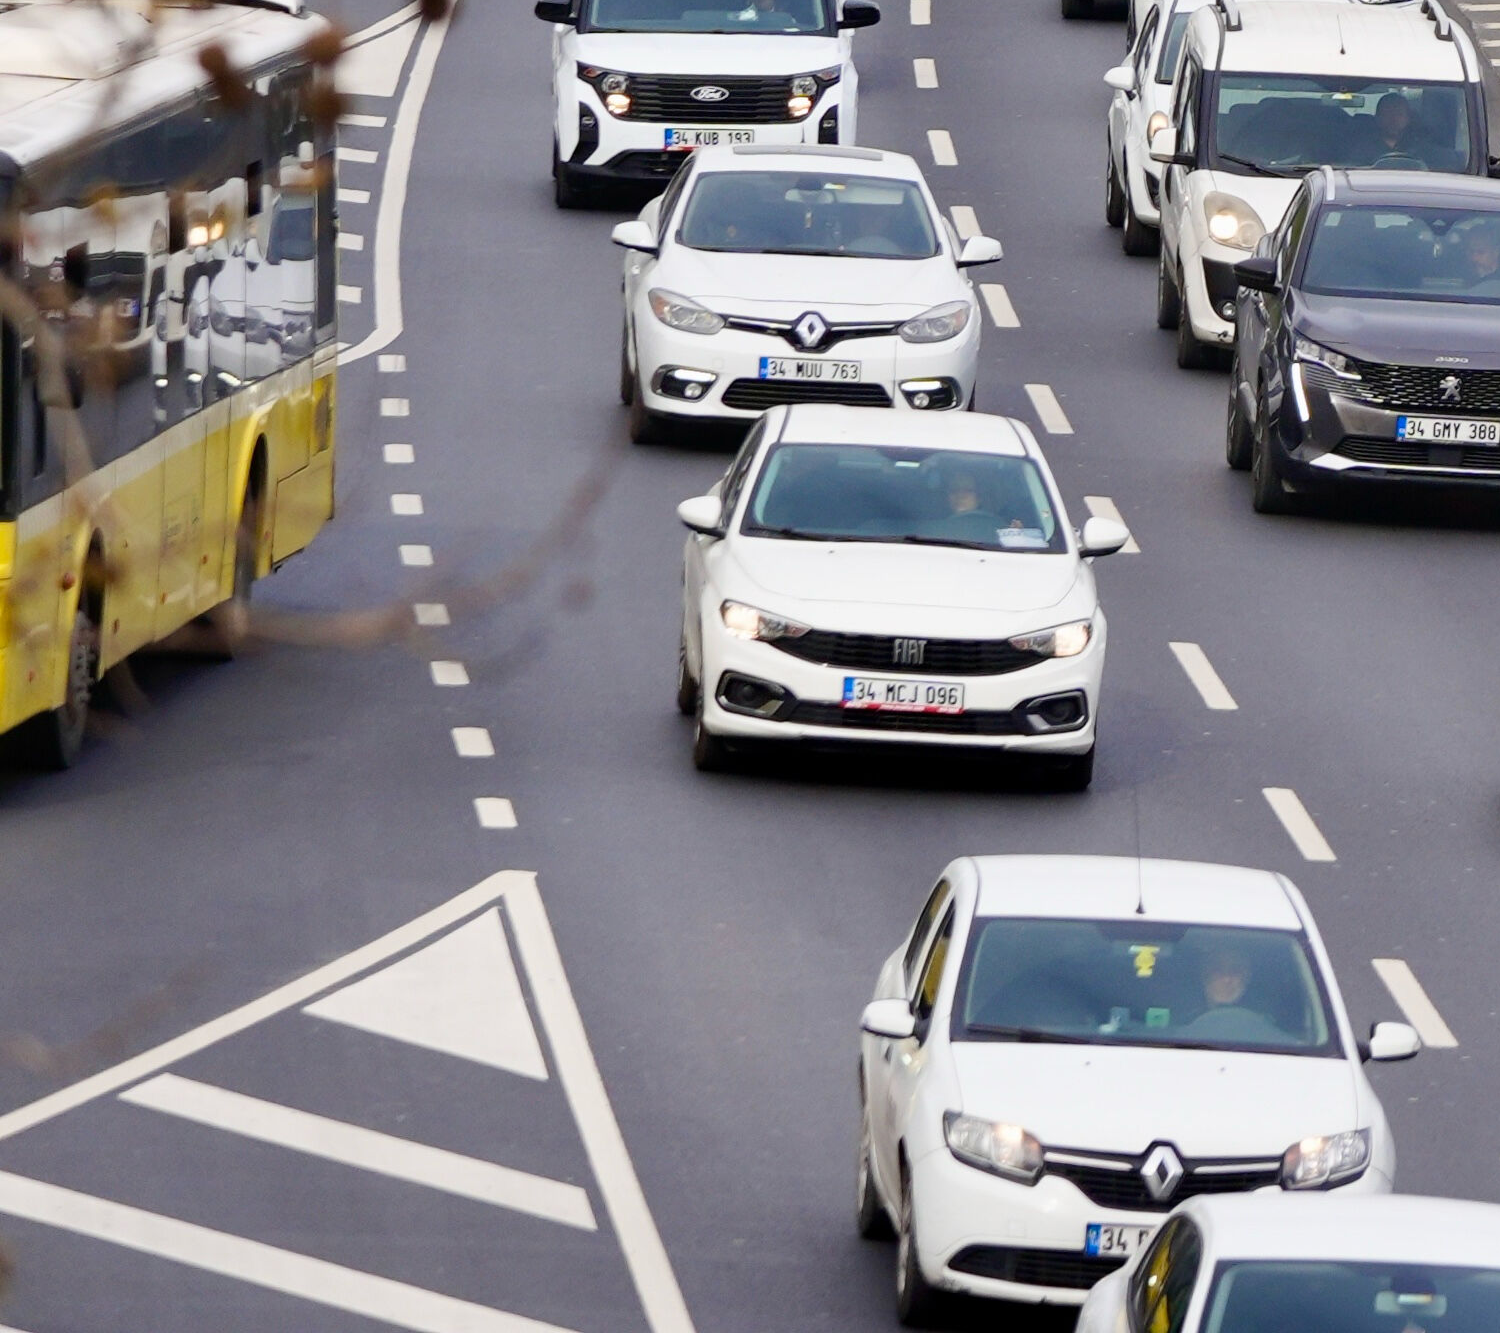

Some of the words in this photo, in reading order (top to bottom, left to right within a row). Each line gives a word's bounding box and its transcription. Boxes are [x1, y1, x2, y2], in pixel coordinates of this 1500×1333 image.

[673, 131, 689, 145] 34
[695, 132, 720, 146] KUB
[769, 363, 787, 377] 34
[797, 364, 823, 379] MUU
[831, 364, 860, 380] 763
[1406, 422, 1425, 437] 34
[1432, 422, 1461, 440] GMY
[1469, 423, 1497, 441] 388
[893, 638, 929, 665] FIAT
[855, 684, 877, 701] 34
[885, 684, 919, 703] MCJ
[925, 685, 959, 706] 096
[1102, 1229, 1128, 1252] 34
